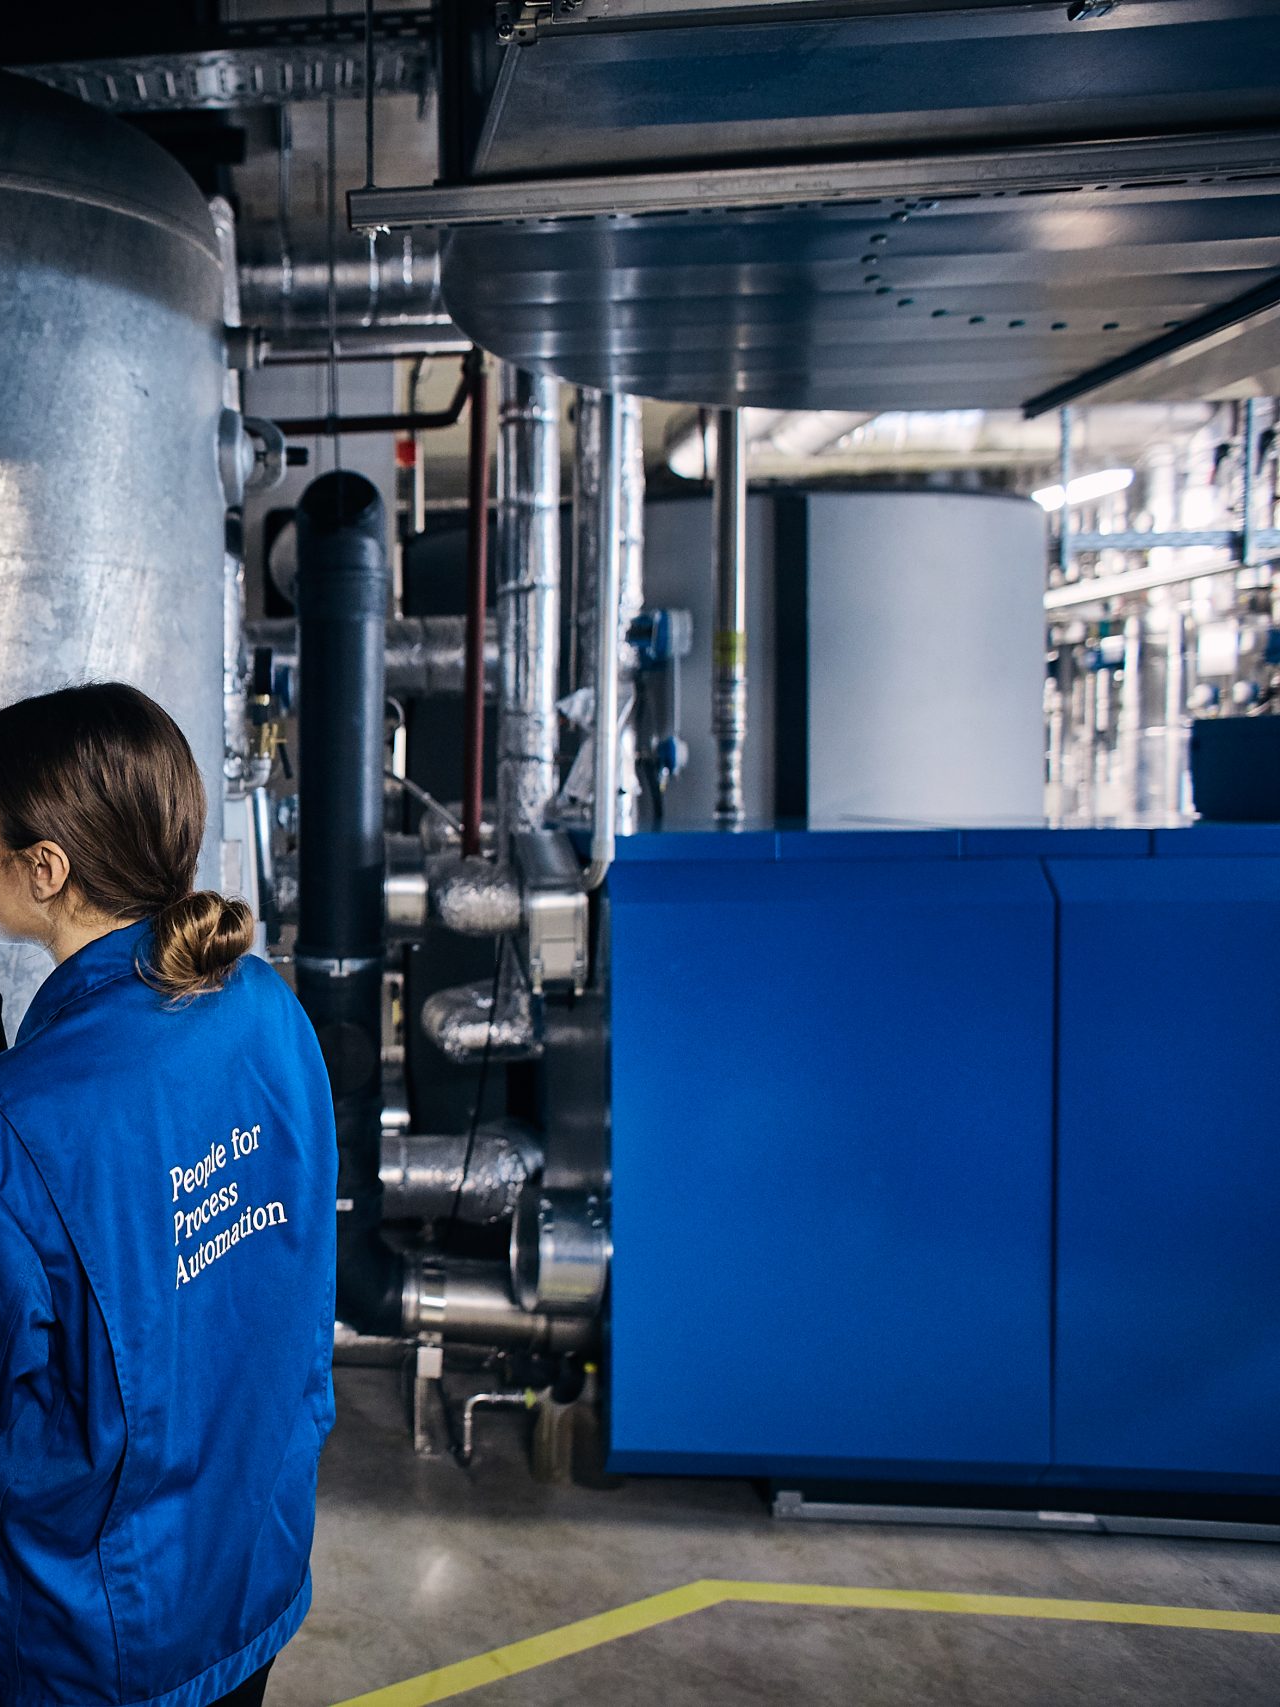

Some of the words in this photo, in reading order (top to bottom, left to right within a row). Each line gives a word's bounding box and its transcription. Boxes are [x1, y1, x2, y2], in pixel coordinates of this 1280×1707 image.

[169, 1141, 227, 1203] People
[231, 1124, 261, 1160] for
[173, 1182, 239, 1246] Process
[175, 1200, 288, 1291] Automation
